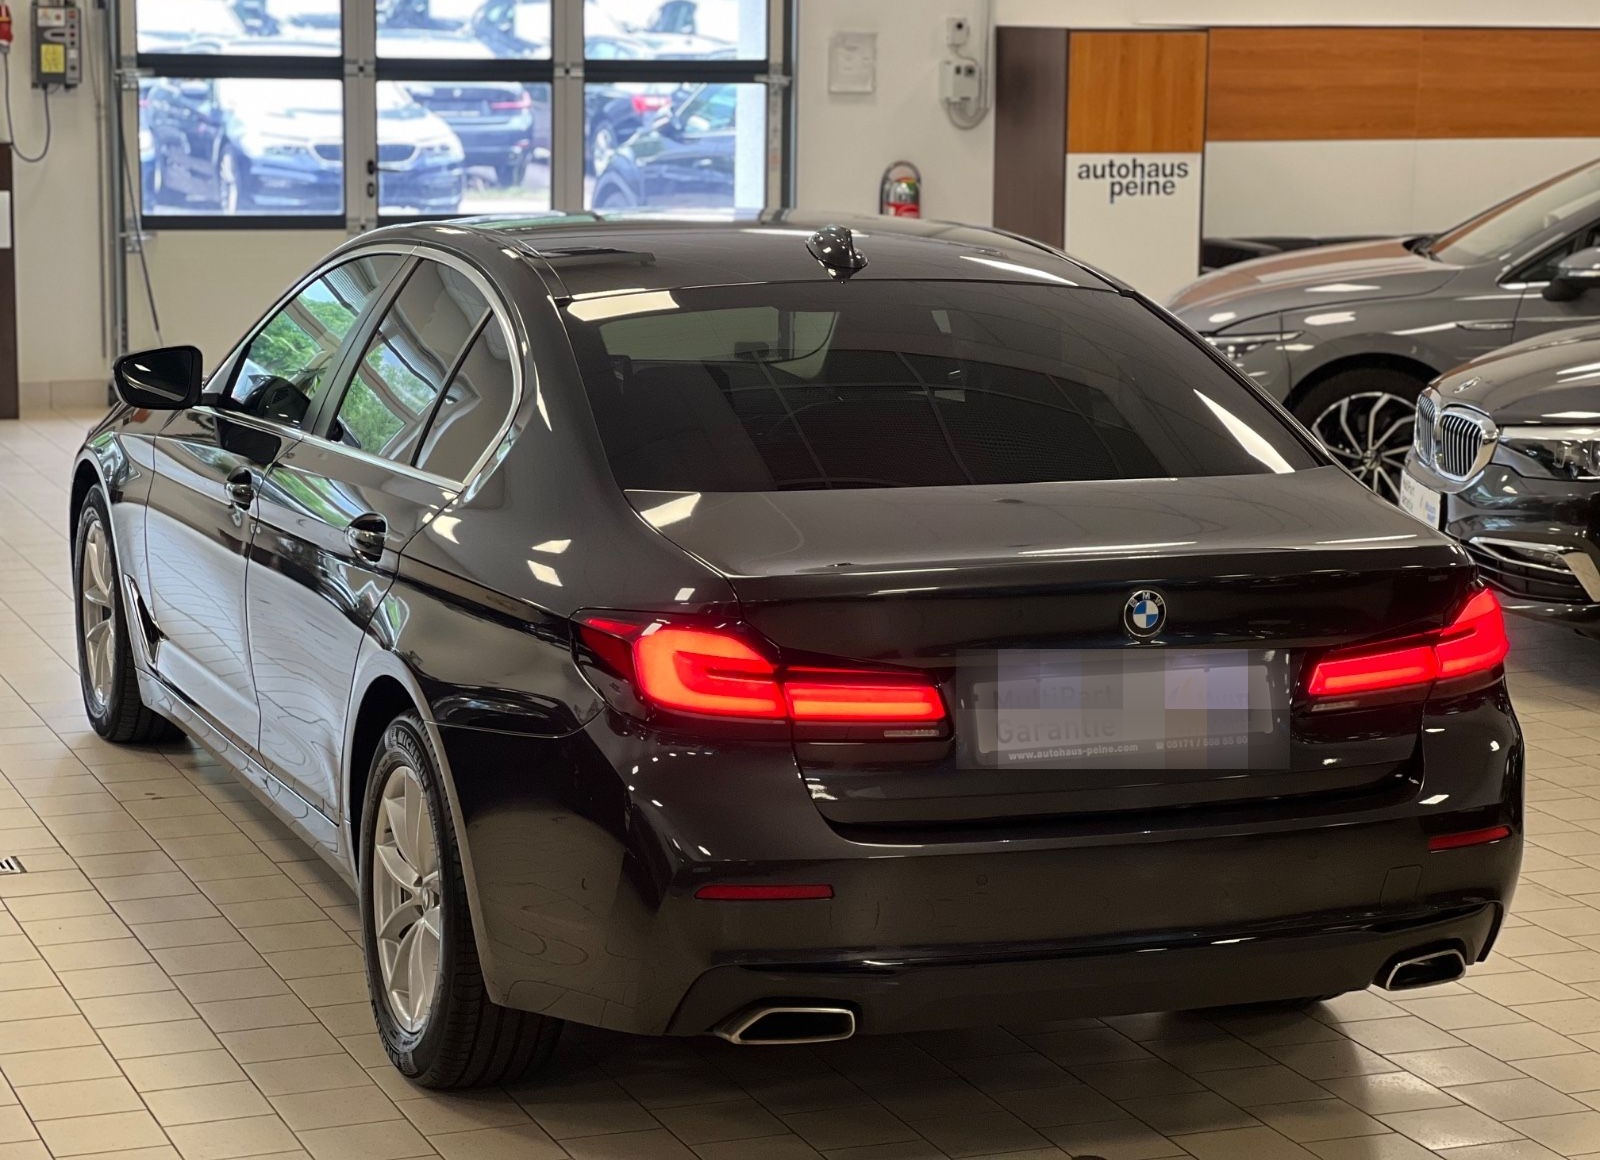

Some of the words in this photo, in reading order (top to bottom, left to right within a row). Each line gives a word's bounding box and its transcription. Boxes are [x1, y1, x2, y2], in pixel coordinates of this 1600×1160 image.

[1077, 158, 1189, 180] autohaus
[1109, 179, 1176, 204] peine
[1129, 591, 1163, 608] BMW
[995, 718, 1116, 744] Garantie
[397, 730, 428, 788] MICHELIN
[1008, 743, 1139, 761] www.autohaus-peine.com
